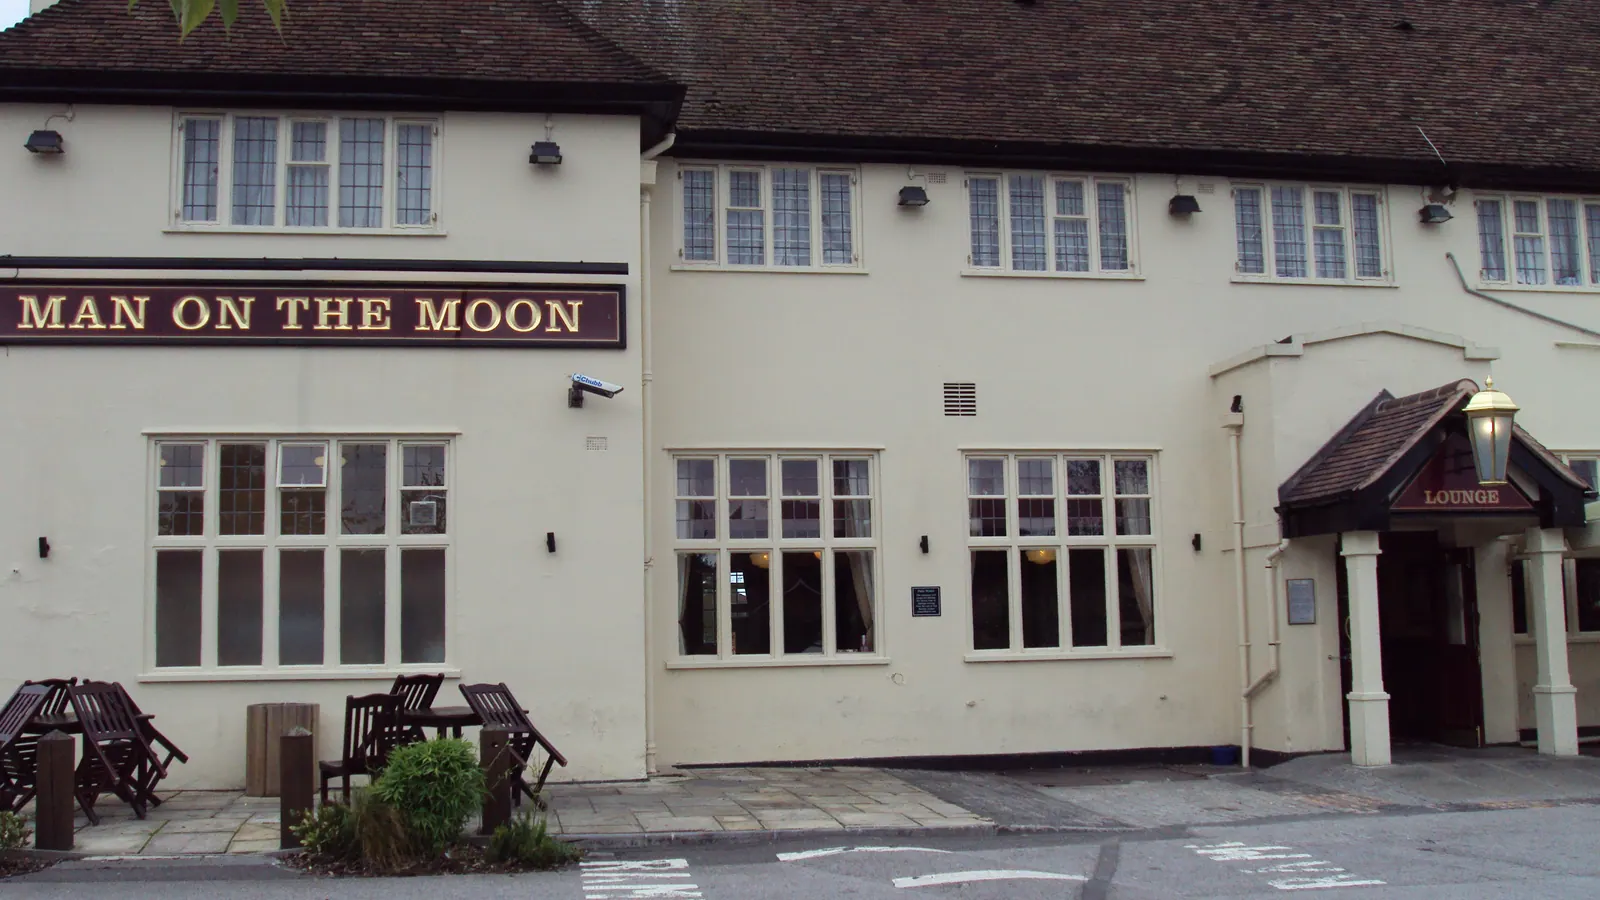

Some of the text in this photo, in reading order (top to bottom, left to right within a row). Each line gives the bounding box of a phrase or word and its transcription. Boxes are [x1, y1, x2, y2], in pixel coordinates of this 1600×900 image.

[17, 295, 583, 333] MAN ON THE MOON
[581, 376, 603, 387] Chubb
[1425, 490, 1499, 504] LOUNGE
